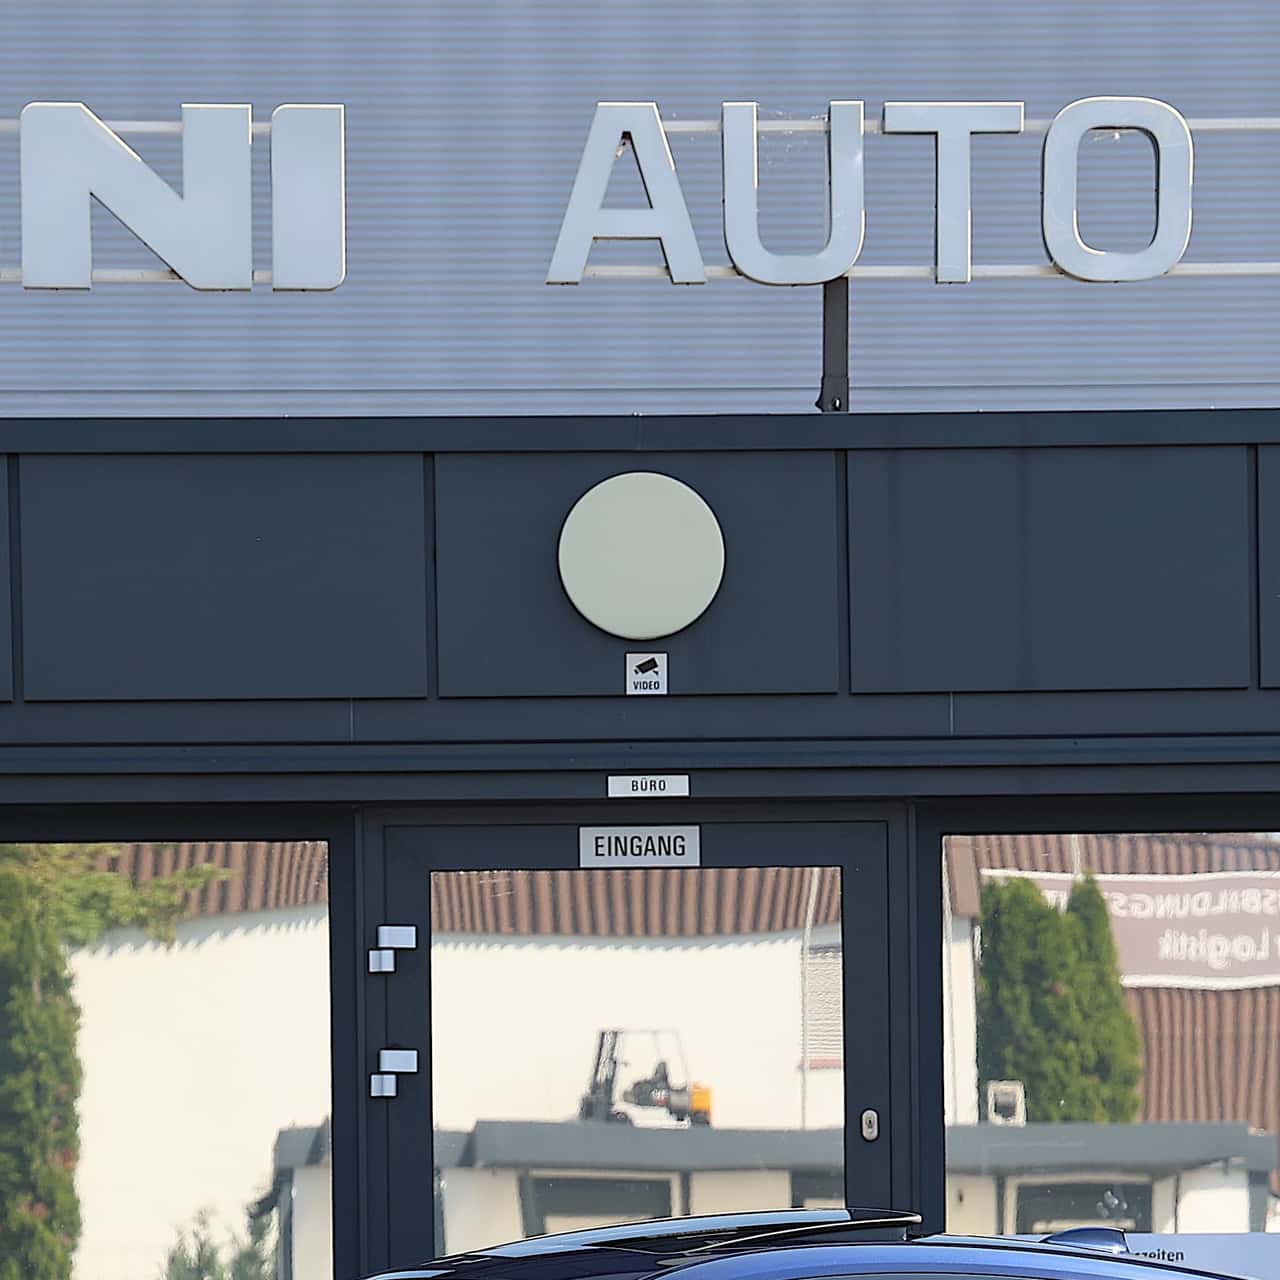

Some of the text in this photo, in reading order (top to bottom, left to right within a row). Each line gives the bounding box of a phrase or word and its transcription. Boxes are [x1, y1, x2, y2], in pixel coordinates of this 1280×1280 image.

[547, 95, 1194, 285] AUTO
[633, 681, 660, 690] VIDEO
[631, 777, 666, 792] BÜRO
[594, 835, 686, 857] EINGANG
